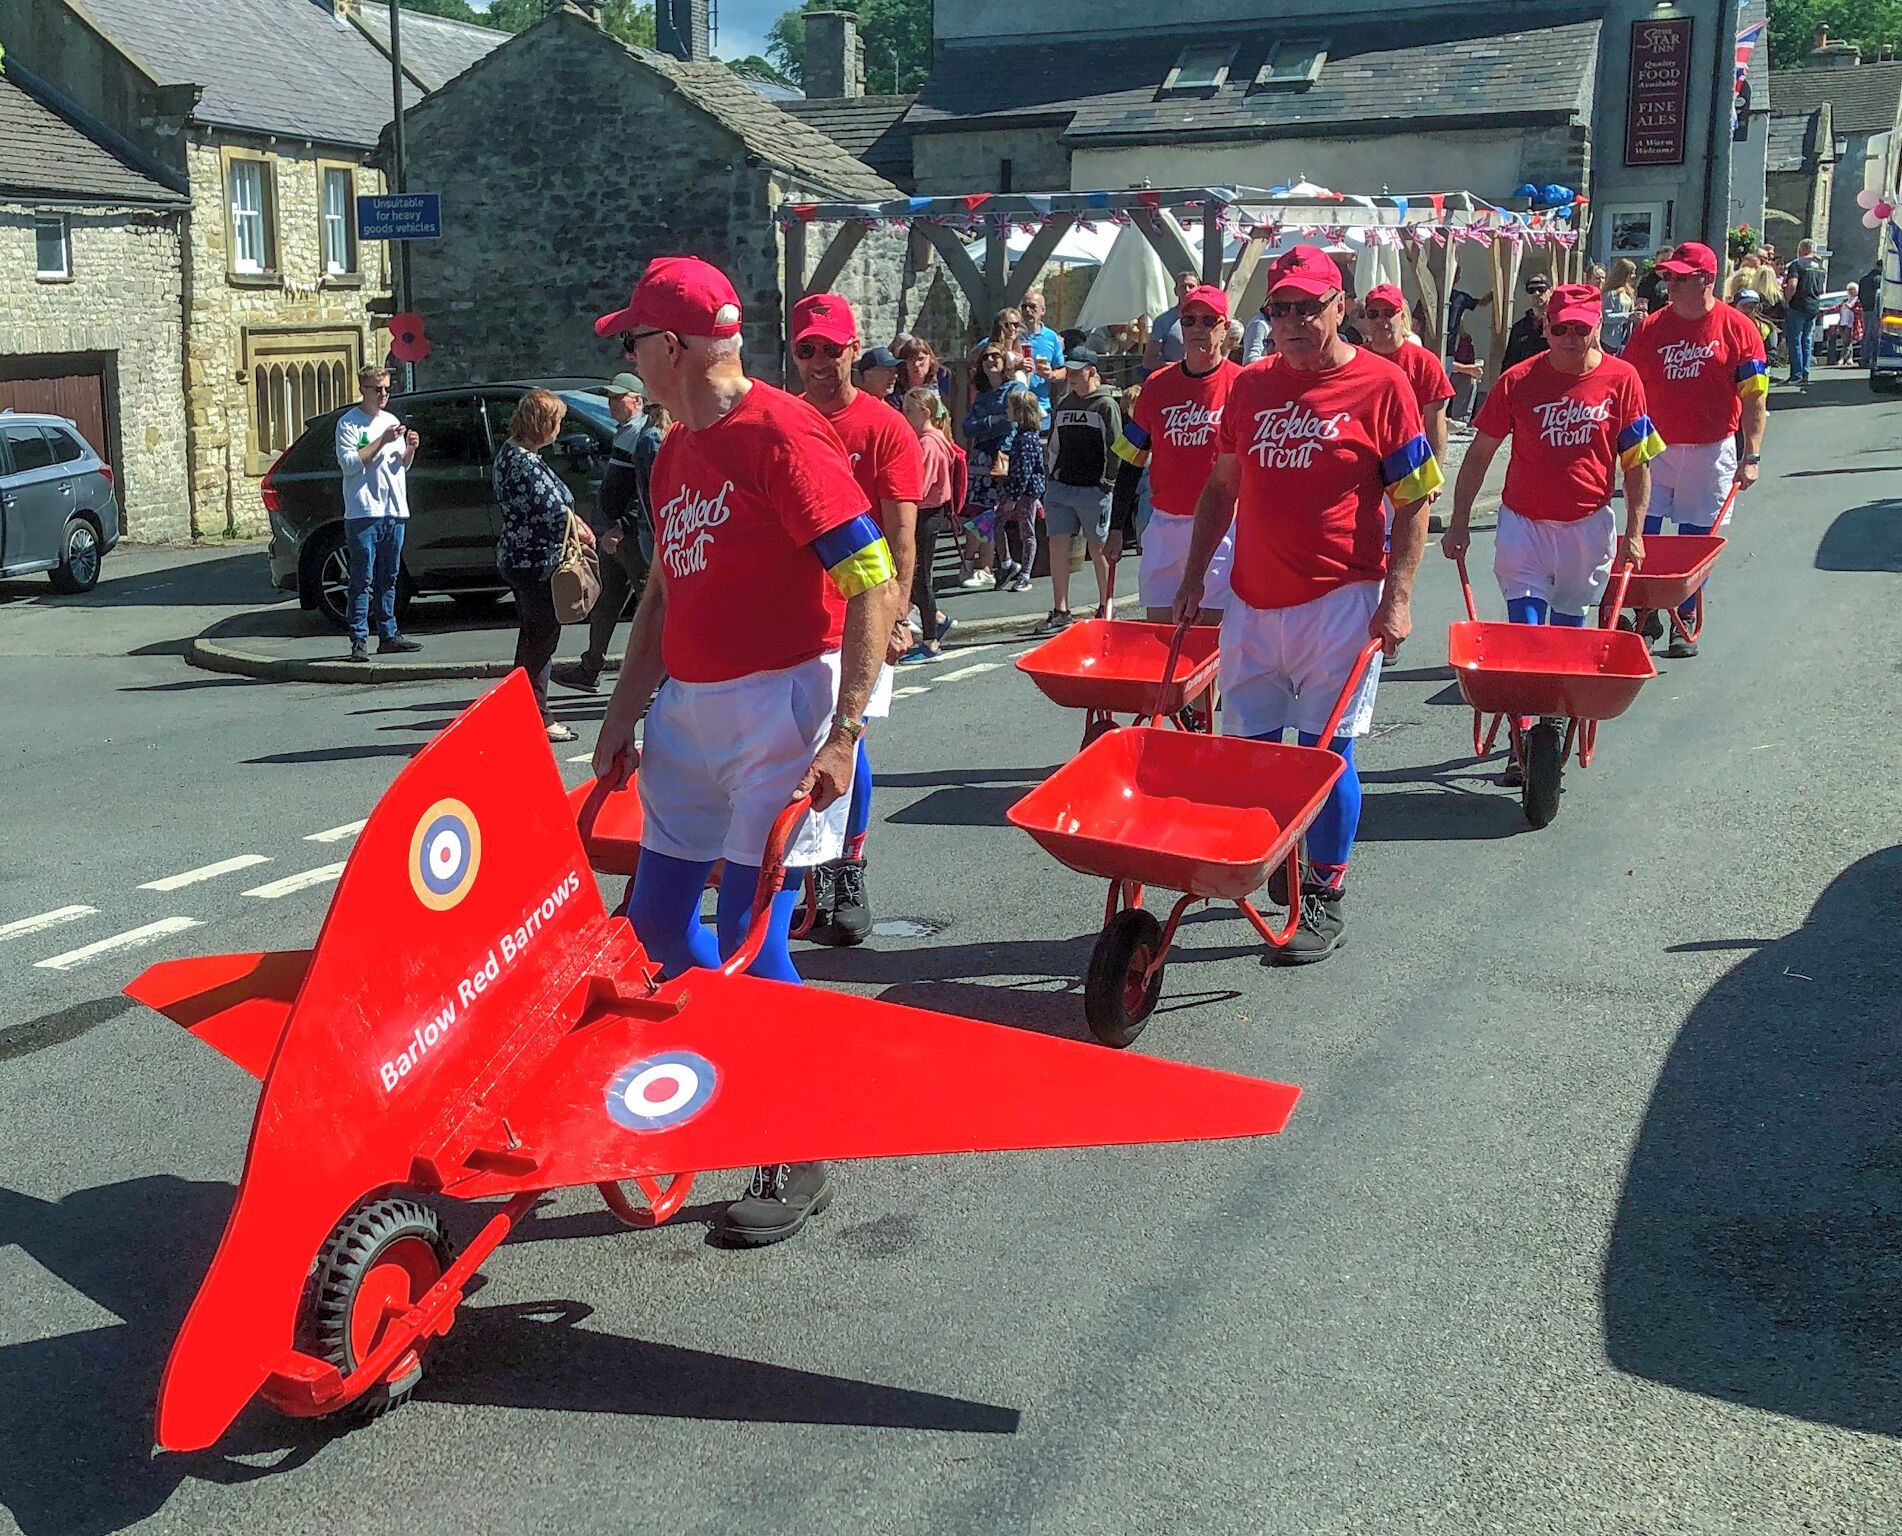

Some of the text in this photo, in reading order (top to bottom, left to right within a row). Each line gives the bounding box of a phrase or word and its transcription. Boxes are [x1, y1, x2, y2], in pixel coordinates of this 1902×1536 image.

[1652, 44, 1675, 54] INN
[1644, 60, 1676, 69] Quality
[1639, 69, 1680, 80] FOOD
[1638, 79, 1679, 89] Available
[1638, 101, 1676, 113] FINE
[1636, 114, 1678, 127] ALES
[1635, 139, 1674, 147] A Warm
[1635, 147, 1675, 155] Welcome
[373, 197, 425, 209] Unsuitable
[376, 210, 422, 222] for heavy
[363, 222, 436, 236] goods vehicles
[1657, 340, 1720, 367] Tickled
[1663, 359, 1706, 380] Trout
[1062, 412, 1088, 423] FILA
[1161, 400, 1225, 432] Tickled
[1532, 396, 1614, 430] Tickled
[1253, 401, 1351, 447] Tickled
[1540, 421, 1600, 447] Trout
[1247, 439, 1323, 469] Trout
[659, 480, 734, 548] Tickled
[664, 529, 715, 578] Trout
[379, 869, 581, 1093] Barlow Red Barrows
